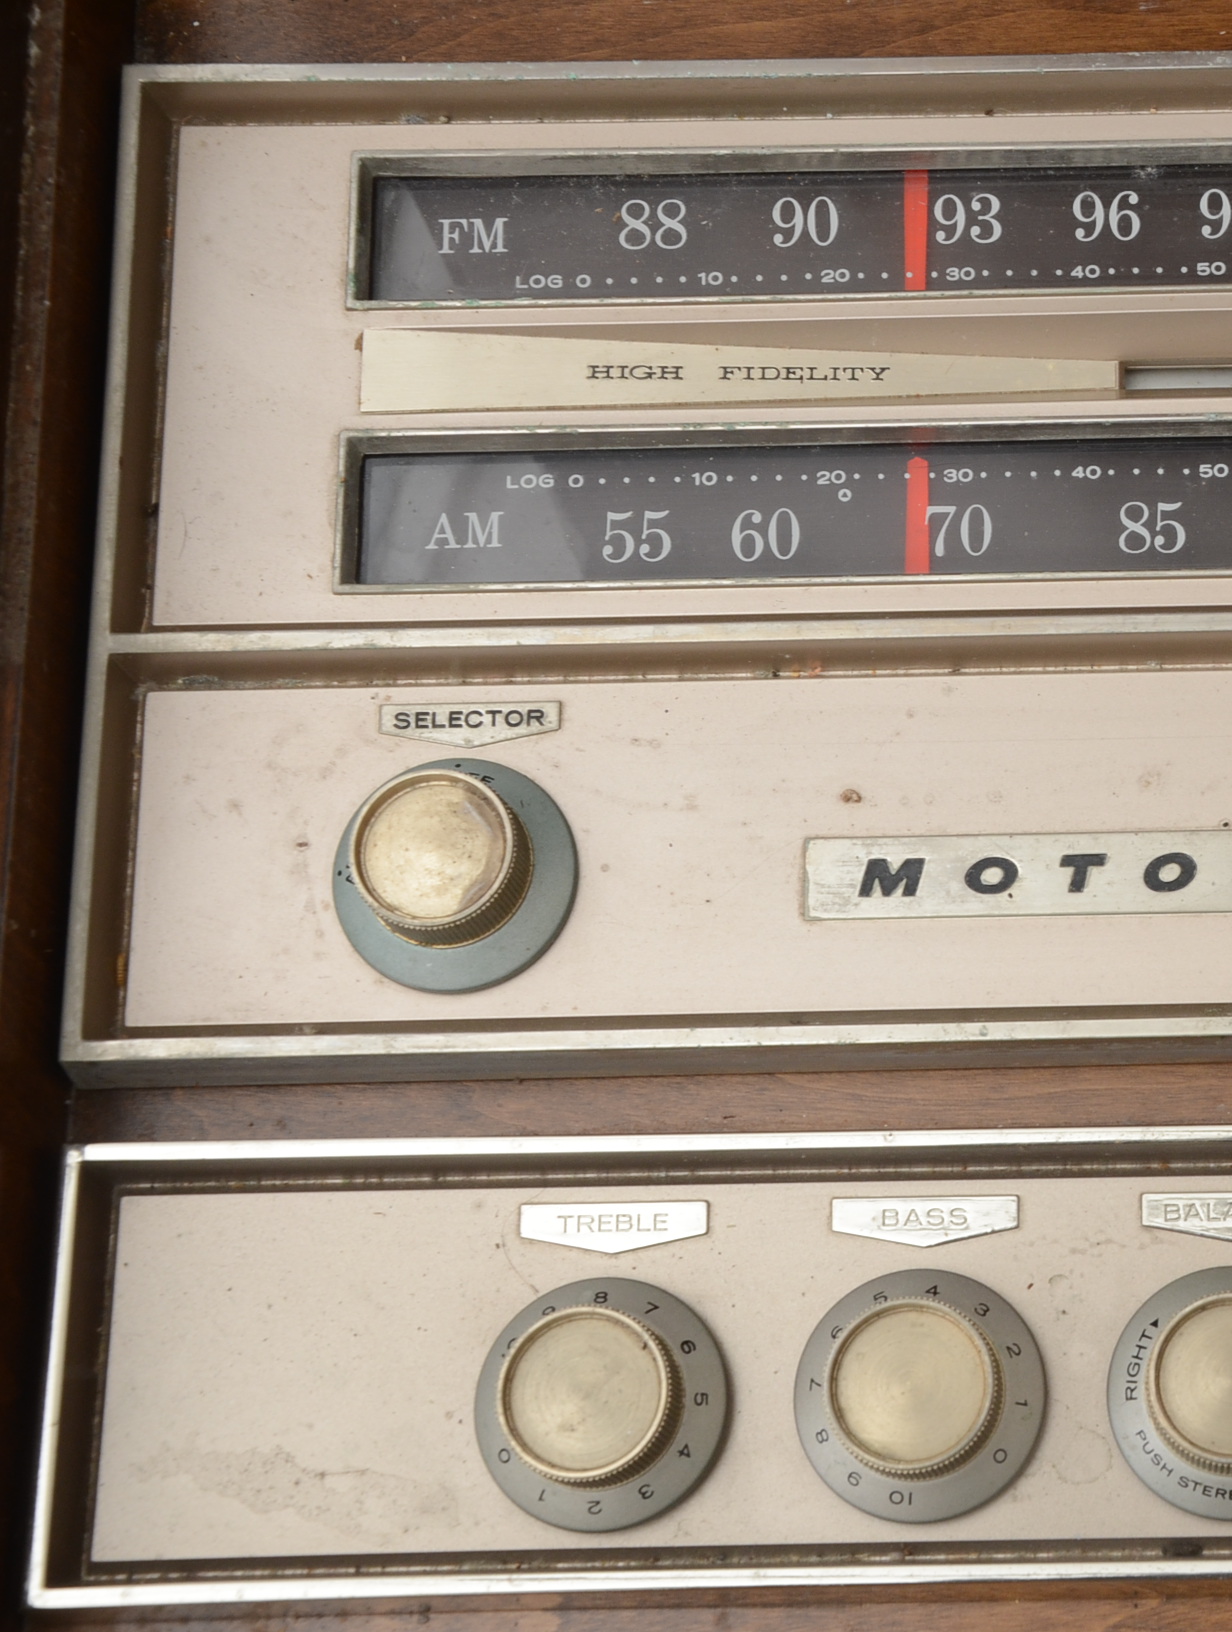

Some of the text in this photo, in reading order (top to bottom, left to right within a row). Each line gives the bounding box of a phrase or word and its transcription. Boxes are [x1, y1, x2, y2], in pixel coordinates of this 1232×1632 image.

[437, 217, 509, 254] FM
[617, 199, 688, 250] 88
[772, 196, 839, 247] 90
[934, 192, 1002, 244] 93
[1073, 191, 1140, 241] 96
[514, 274, 562, 288] LOG
[575, 274, 592, 287] 0
[697, 271, 724, 286] 10
[820, 268, 851, 283] 20
[946, 267, 976, 281] 30
[1070, 265, 1100, 278] 40
[1197, 262, 1226, 276] 50
[586, 365, 890, 382] HIGH FIDELITY
[505, 474, 554, 488] LOG
[568, 474, 584, 487] 0
[691, 471, 718, 485] 10
[816, 470, 846, 484] 20
[942, 468, 973, 482] 30
[1071, 466, 1102, 479] 40
[1199, 464, 1229, 478] 50
[424, 511, 504, 550] AM
[601, 509, 671, 563] 55
[730, 506, 800, 560] 60
[928, 504, 992, 556] 70
[1118, 501, 1186, 554] 85
[393, 709, 545, 729] SELECTOR
[557, 1213, 669, 1234] TREBLE
[882, 1208, 968, 1228] BASS
[925, 1285, 940, 1297] 4
[974, 1303, 990, 1317] 3
[1006, 1343, 1022, 1358] 2
[1125, 1329, 1154, 1401] RIGHT
[809, 1378, 822, 1391] 7
[498, 1291, 708, 1515] 8 7 6 5 4 3 2 1 0
[1015, 1400, 1028, 1408] 1
[816, 1429, 829, 1444] 8
[993, 1448, 1007, 1464] 0
[1135, 1430, 1173, 1478] PUSH
[847, 1471, 862, 1486] 9
[889, 1490, 912, 1506] 10
